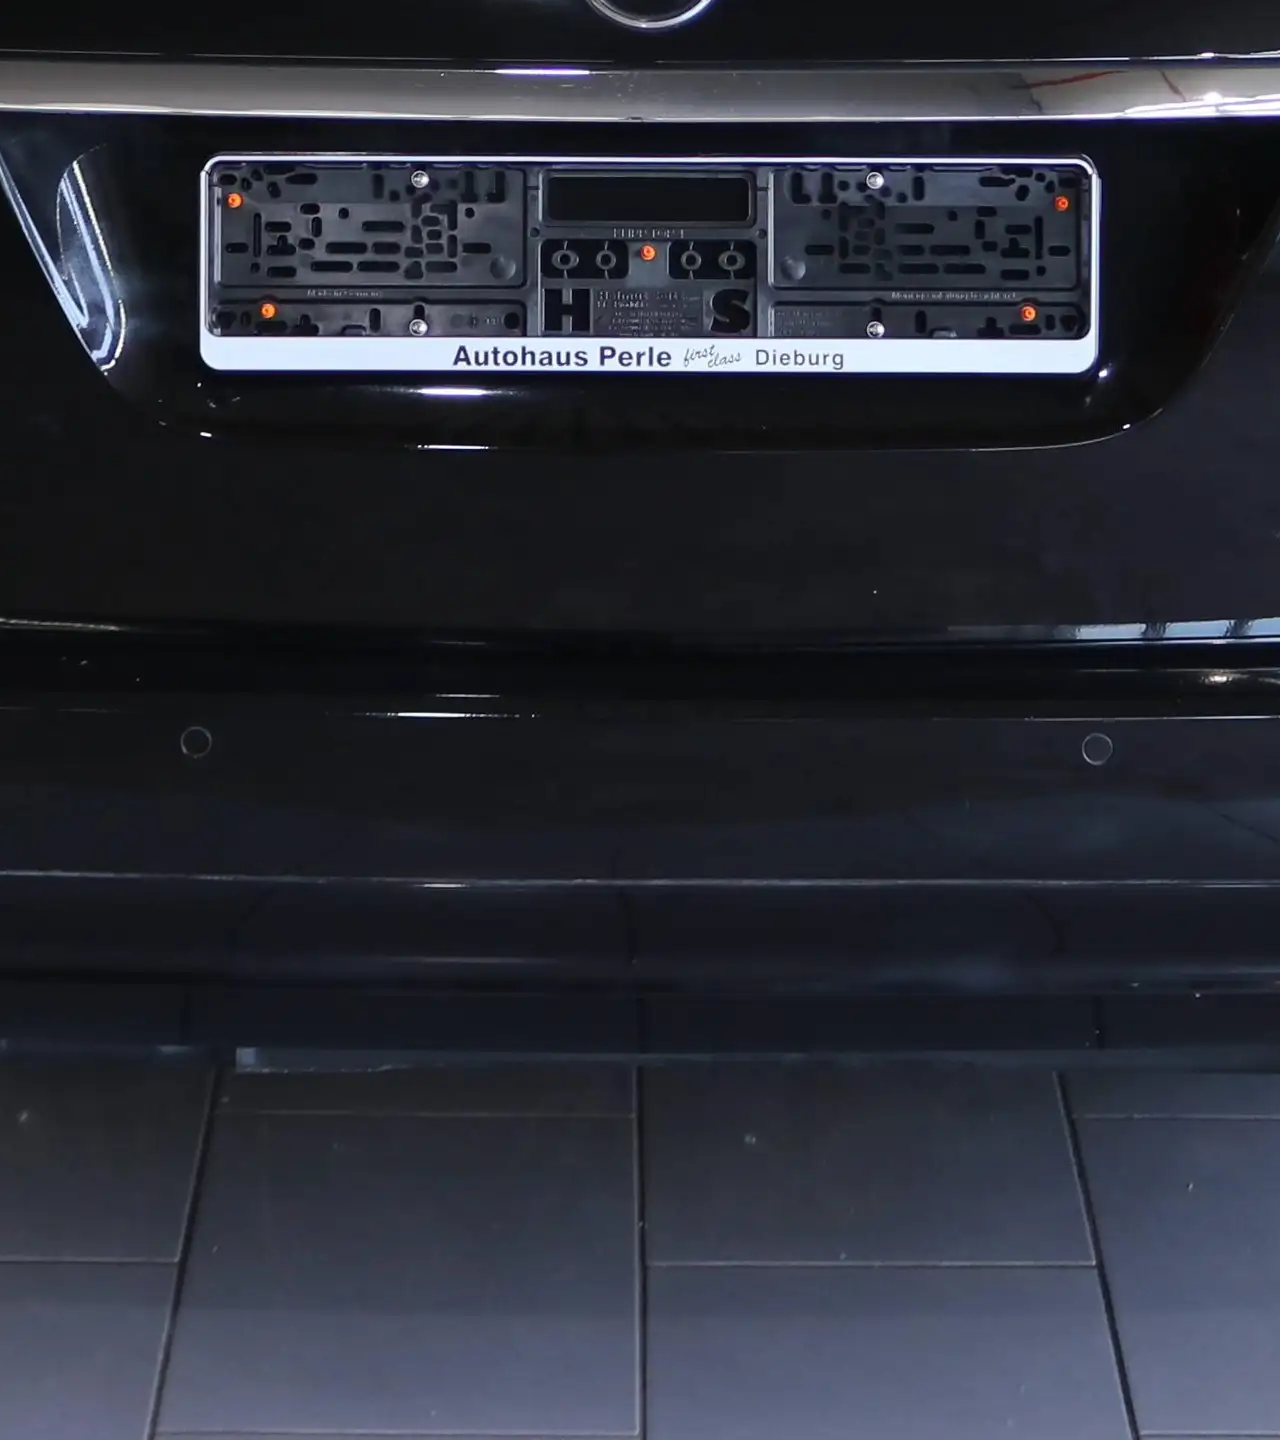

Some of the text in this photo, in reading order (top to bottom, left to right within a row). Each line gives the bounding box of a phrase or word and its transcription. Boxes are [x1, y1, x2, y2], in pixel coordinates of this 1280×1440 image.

[543, 287, 591, 333] H
[709, 287, 752, 334] S
[452, 344, 588, 367] Autohaus
[599, 344, 672, 367] Perle
[683, 344, 715, 366] first
[755, 348, 845, 370] Dieburg
